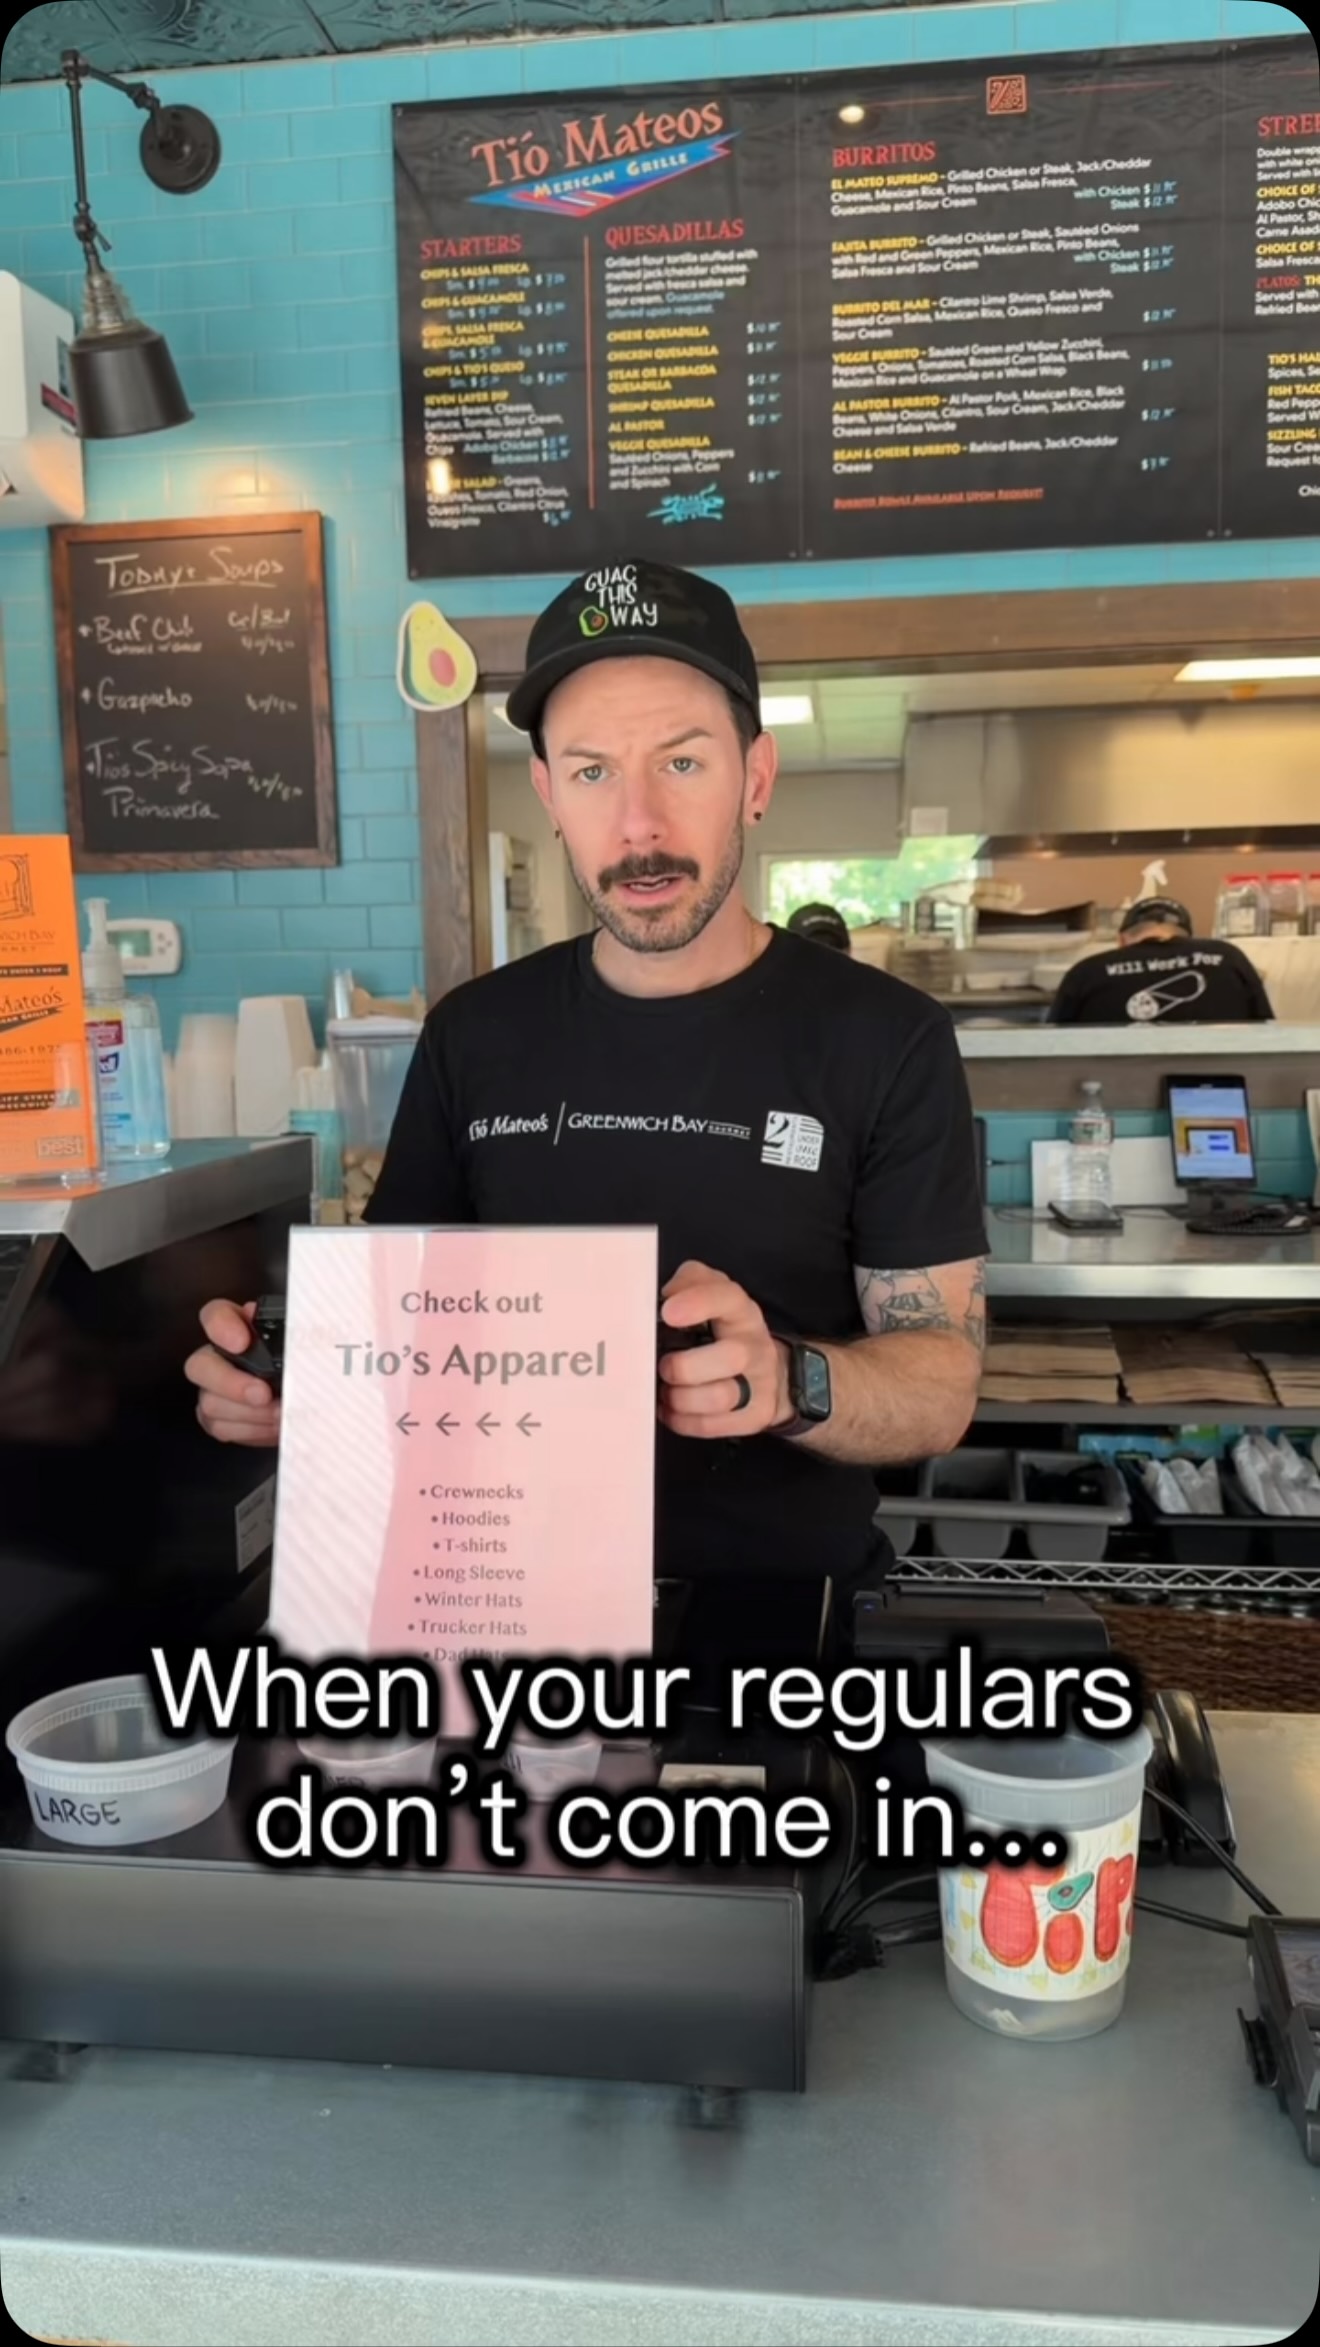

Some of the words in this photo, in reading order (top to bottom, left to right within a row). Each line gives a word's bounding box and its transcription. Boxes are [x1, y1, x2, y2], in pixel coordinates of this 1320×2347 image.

[471, 131, 549, 187] Tió
[562, 102, 724, 168] Mateos
[833, 141, 935, 167] BURRITOS
[533, 168, 616, 199] MEXICAN
[626, 152, 689, 176] GRILLE
[832, 179, 843, 189] EL
[846, 176, 884, 188] MATEO
[887, 173, 938, 186] SUPREMO
[948, 169, 983, 181] Grilled
[986, 167, 1026, 178] Chicken
[1078, 159, 1151, 172] Jack/Cheddar
[1257, 170, 1290, 181] Served
[1293, 169, 1311, 178] with
[875, 189, 918, 200] Mexican
[948, 183, 973, 193] Pinto
[1013, 180, 1039, 189] Salsa
[1074, 189, 1096, 198] with
[1099, 186, 1139, 195] Chicken
[1258, 185, 1297, 198] CHOICE
[1301, 183, 1315, 194] OF
[831, 205, 890, 216] Guacamole
[894, 201, 913, 211] and
[916, 200, 938, 210] Sour
[942, 198, 976, 208] Cream
[1111, 199, 1139, 209] Steak
[606, 219, 743, 249] QUESADILLAS
[870, 238, 917, 249] BURRITO
[927, 234, 962, 246] Grilled
[965, 233, 1005, 242] Chicken
[1102, 224, 1139, 234] Onions
[421, 235, 522, 259] STARTERS
[1098, 250, 1139, 261] Chicken
[1256, 243, 1297, 255] CHOICE
[1300, 242, 1314, 252] OF
[856, 254, 876, 263] Red
[878, 251, 897, 261] and
[901, 251, 933, 261] Green
[832, 268, 858, 279] Salsa
[861, 266, 893, 276] Fresca
[896, 263, 915, 274] and
[918, 262, 940, 273] Sour
[943, 260, 978, 271] Cream
[1111, 263, 1139, 273] Steak
[1255, 291, 1294, 303] Served
[1297, 289, 1318, 300] with
[1267, 412, 1305, 423] Served
[584, 564, 637, 592] GUAC
[597, 582, 638, 609] THIS
[610, 602, 657, 627] WAY
[92, 614, 147, 646] Beef
[103, 787, 220, 819] Primavera
[568, 1112, 668, 1132] GREENWICH
[671, 1110, 708, 1132] BAY
[400, 1289, 489, 1313] Check
[496, 1292, 543, 1313] out
[334, 1341, 431, 1376] Tio's
[441, 1340, 606, 1385] Apparel
[431, 1484, 524, 1499] Crewnecks
[442, 1512, 510, 1526] Hoodies
[445, 1538, 507, 1552] T-shirts
[424, 1566, 465, 1583] Long
[470, 1565, 525, 1580] Sleeve
[425, 1592, 480, 1607] Winter
[486, 1594, 523, 1608] Hats
[420, 1620, 485, 1634] Trucker
[490, 1621, 527, 1635] Hats
[34, 1791, 121, 1827] LARGE
